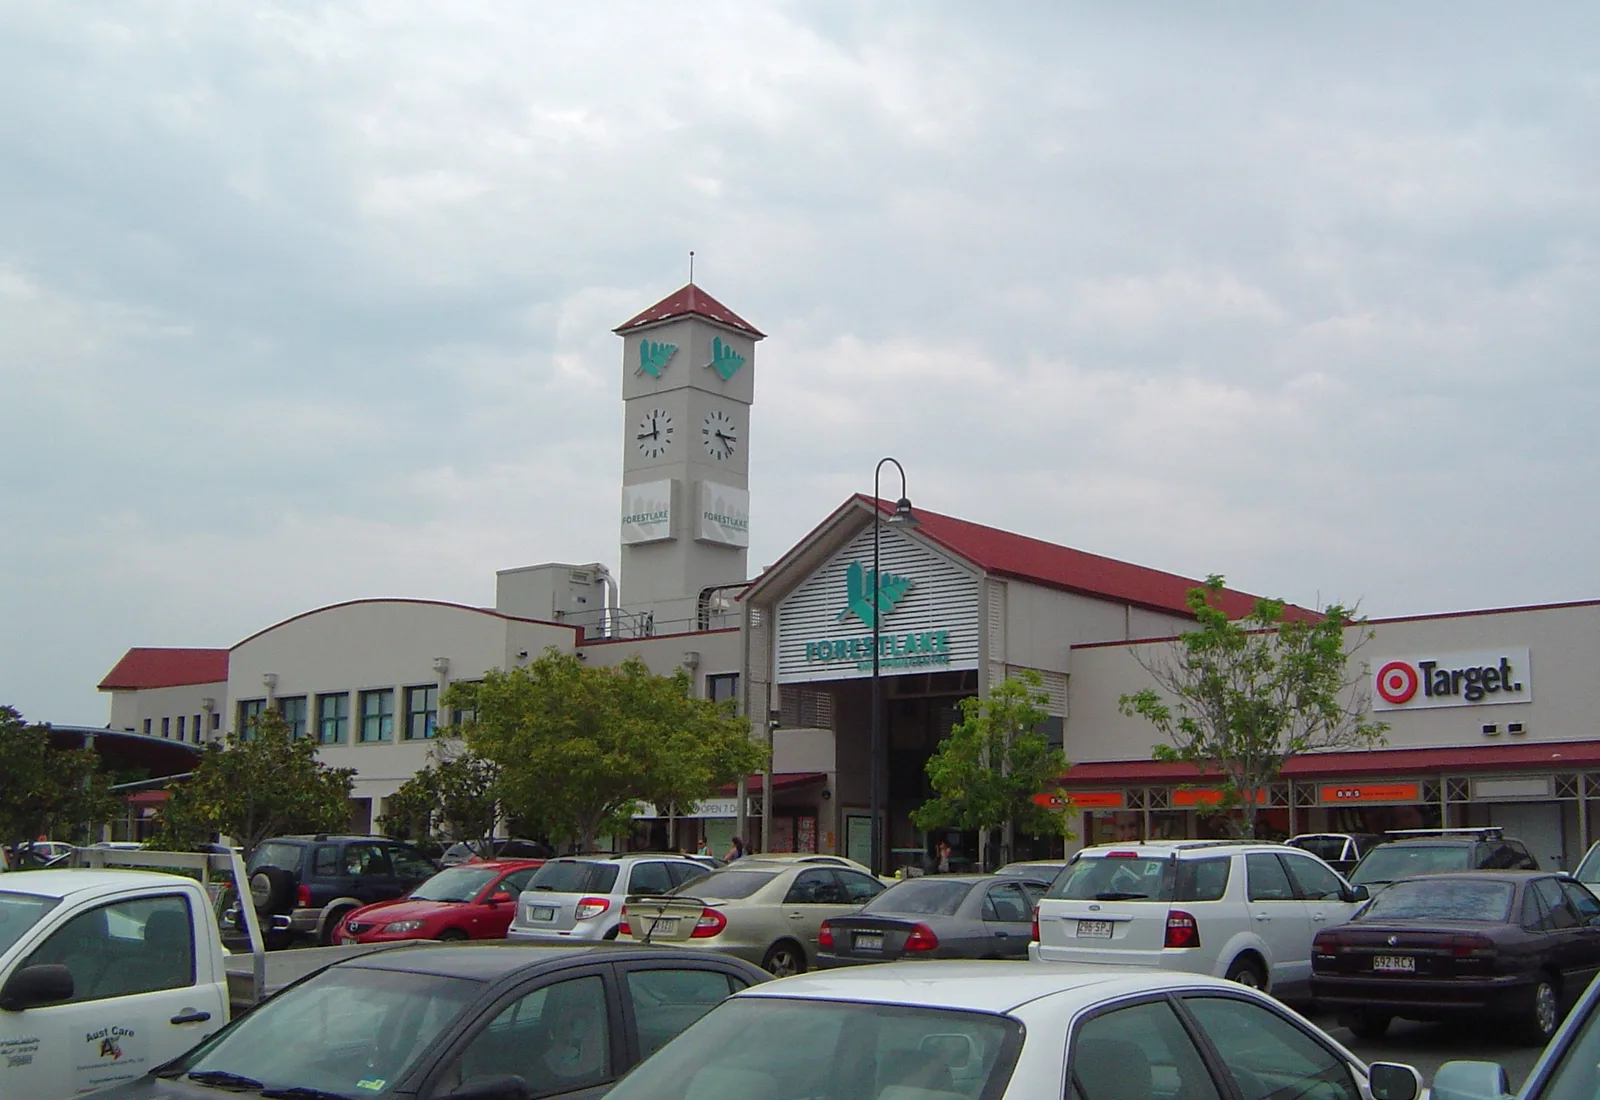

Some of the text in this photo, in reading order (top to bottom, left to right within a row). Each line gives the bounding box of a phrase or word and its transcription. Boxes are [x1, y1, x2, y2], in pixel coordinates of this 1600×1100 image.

[622, 509, 668, 525] FORESTLAKE
[703, 511, 748, 529] FORESTLAKE
[805, 630, 951, 662] FORESTLAKE
[1418, 657, 1522, 701] Target.
[86, 1026, 135, 1043] Aust Care
